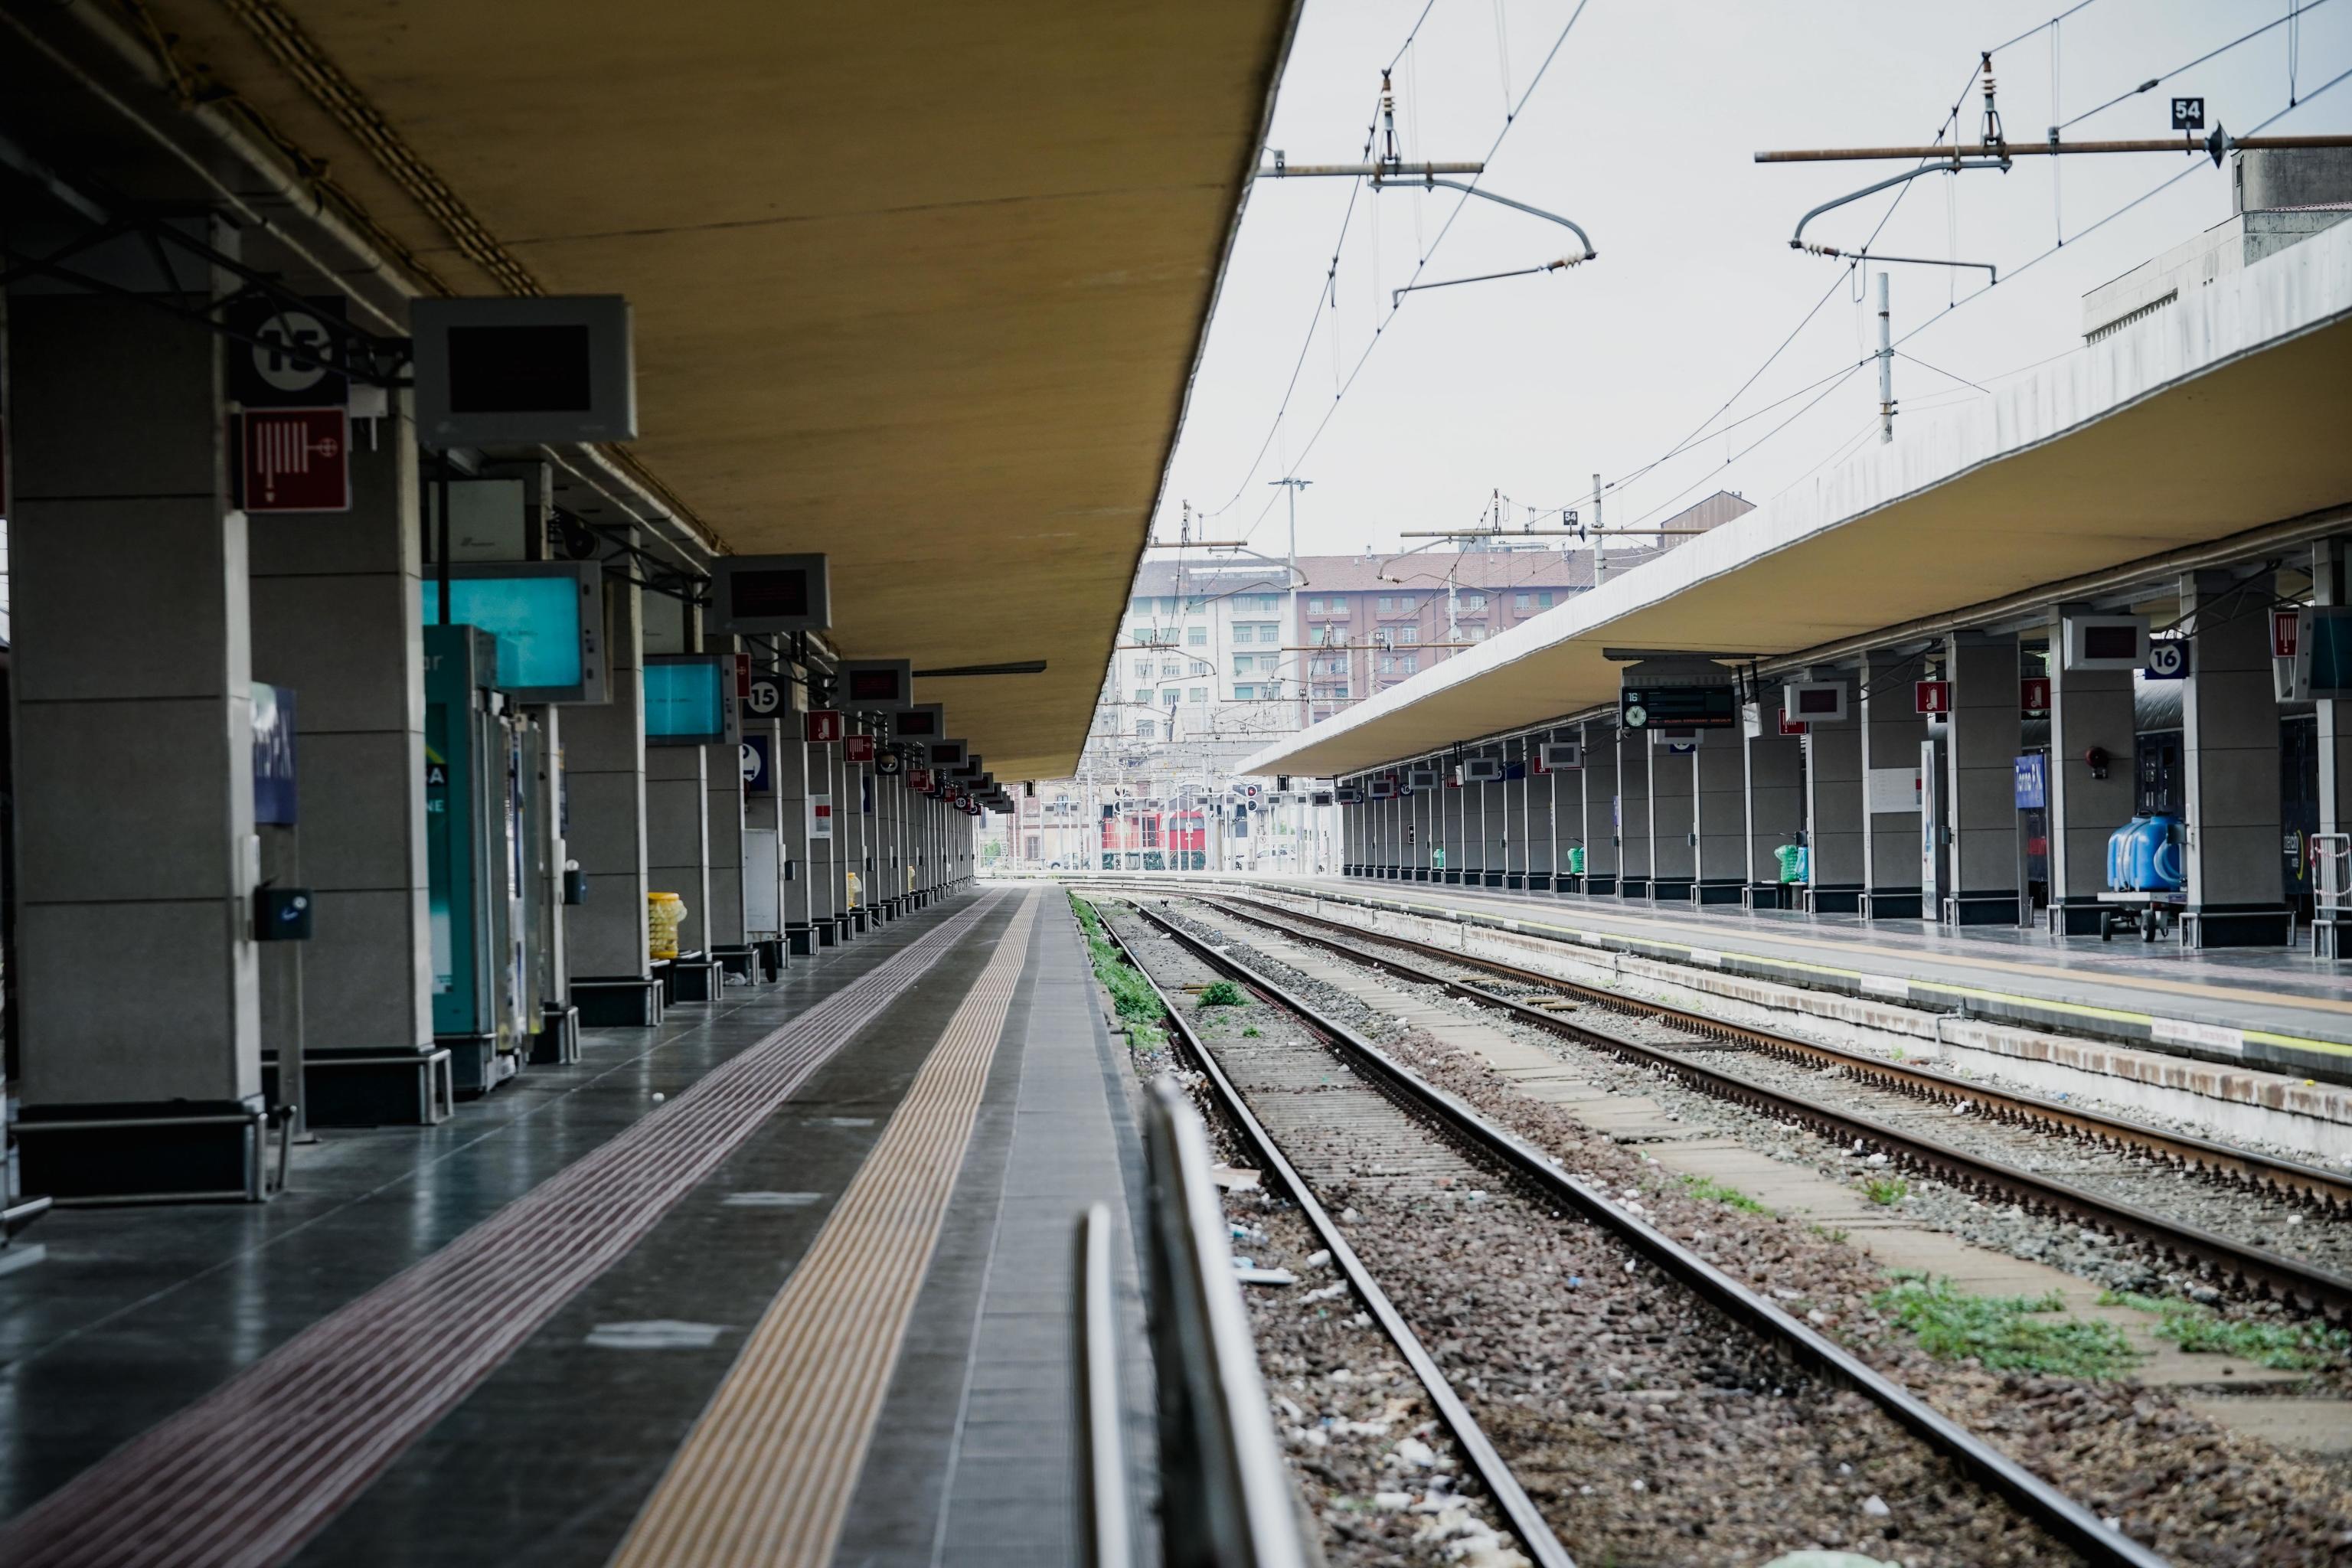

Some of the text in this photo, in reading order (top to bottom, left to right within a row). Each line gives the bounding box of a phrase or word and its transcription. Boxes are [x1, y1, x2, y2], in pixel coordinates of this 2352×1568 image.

[2175, 100, 2201, 119] 54
[263, 330, 320, 372] 15
[1565, 512, 1577, 521] 54
[2154, 650, 2177, 667] 16
[751, 688, 775, 705] 15
[1628, 692, 1638, 701] 16
